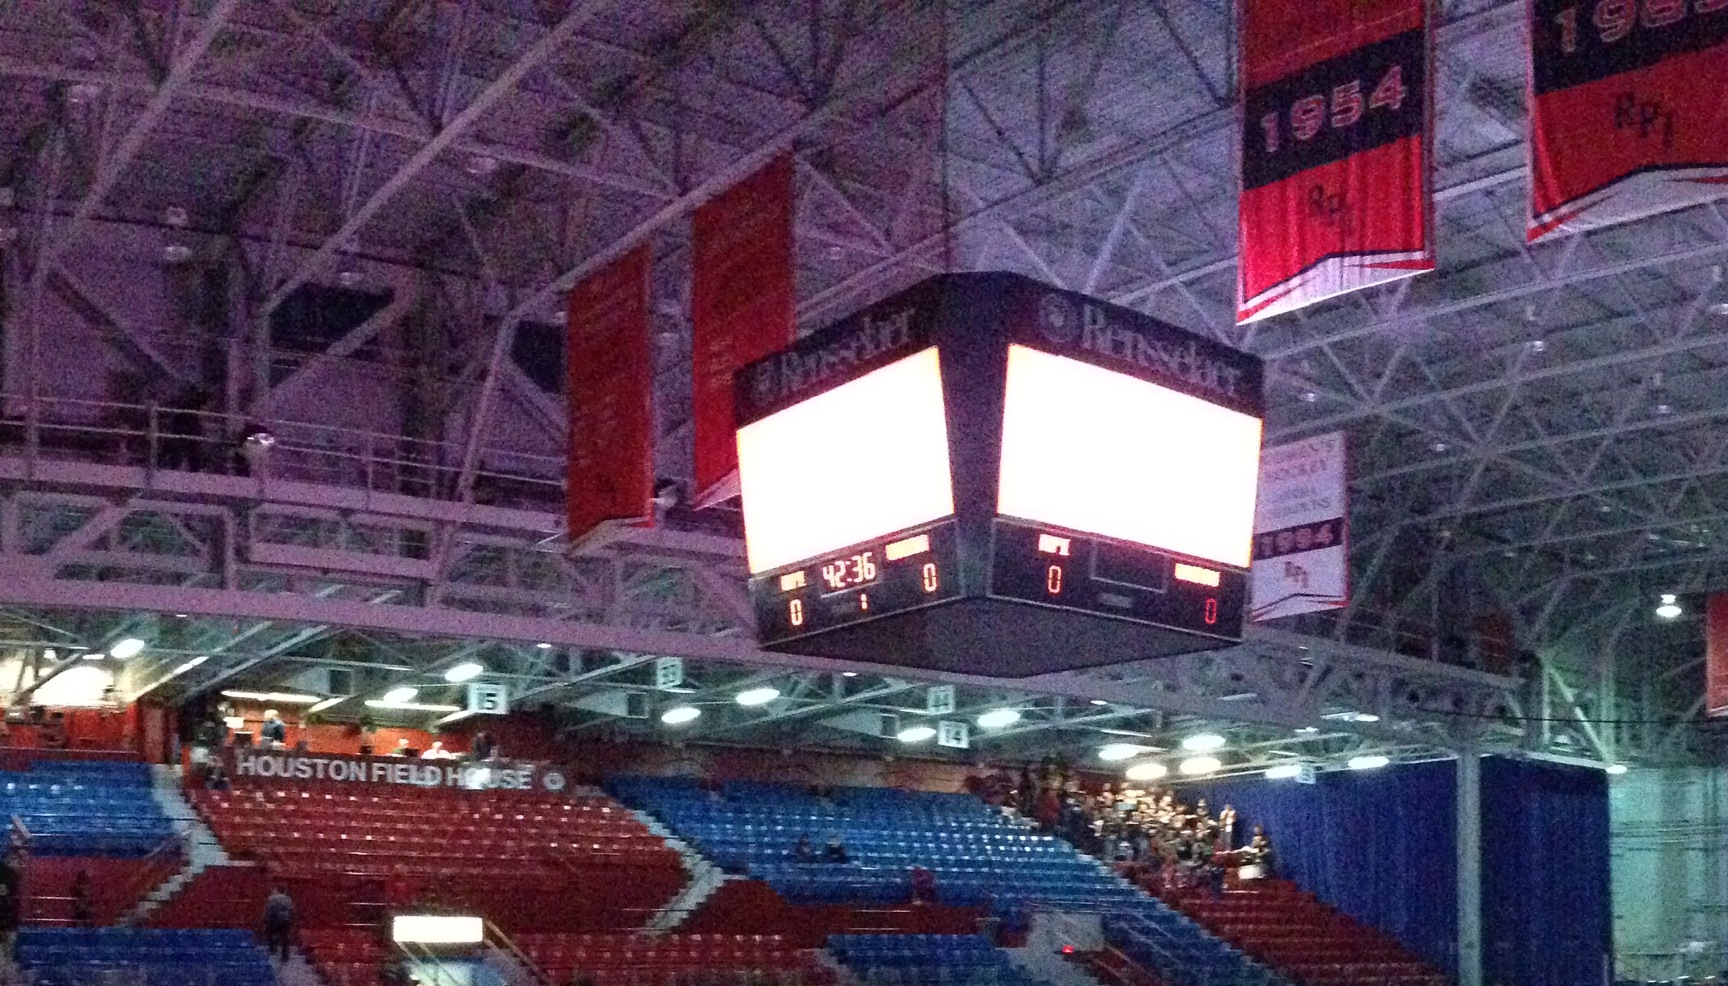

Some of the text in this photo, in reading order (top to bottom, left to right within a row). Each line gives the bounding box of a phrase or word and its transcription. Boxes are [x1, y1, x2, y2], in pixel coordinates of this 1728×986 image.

[1260, 65, 1410, 152] 1954
[823, 552, 876, 588] 42:36
[923, 563, 938, 592] 0
[1048, 565, 1062, 594] 0
[789, 599, 803, 626] 0
[1205, 598, 1217, 625] 0
[237, 754, 366, 783] HOUSTON
[372, 761, 441, 787] FIELD
